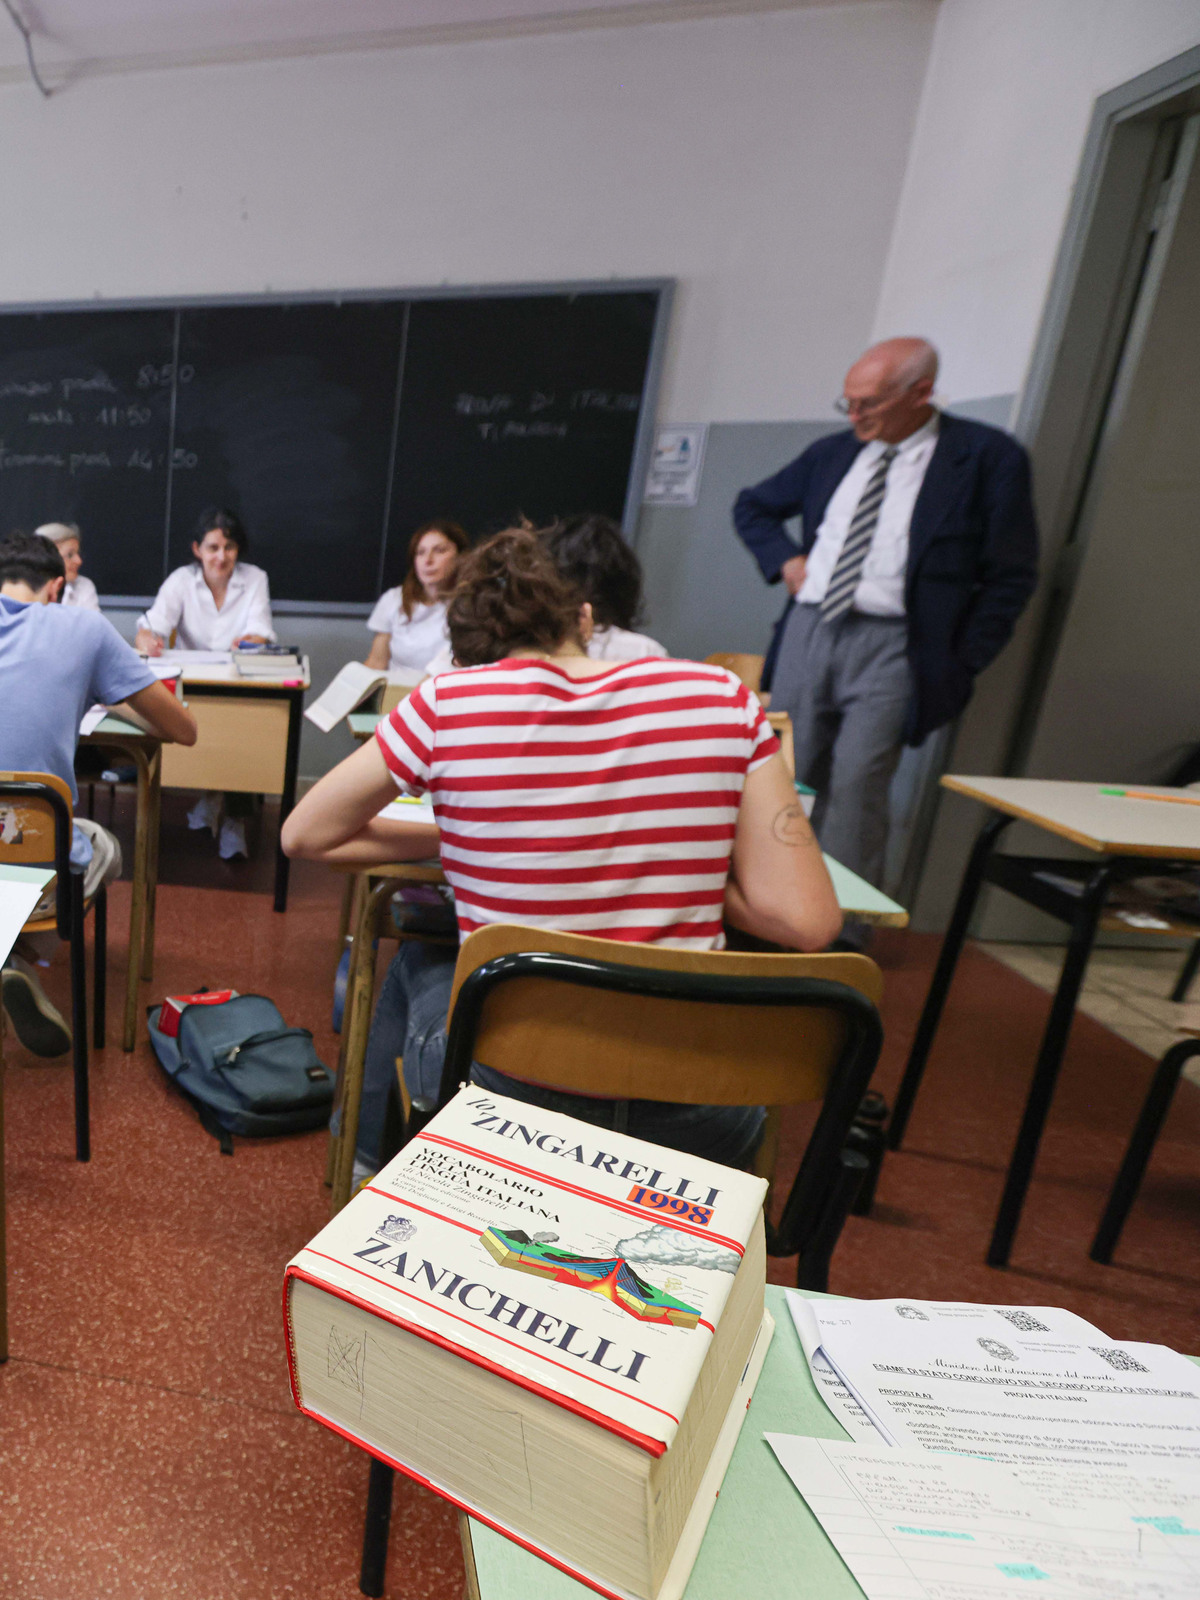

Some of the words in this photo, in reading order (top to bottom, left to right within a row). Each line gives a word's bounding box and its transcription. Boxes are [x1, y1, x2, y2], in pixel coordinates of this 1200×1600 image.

[466, 1098, 497, 1111] lo
[415, 1153, 470, 1178] DELLA
[423, 1147, 544, 1198] VOCABOLARIO
[470, 1111, 724, 1208] ZINGARELLI
[398, 1172, 443, 1190] Dodicesima
[442, 1187, 471, 1204] edizione
[400, 1180, 416, 1189] cura
[409, 1159, 471, 1188] LINGUA
[477, 1185, 561, 1223] ITALIANA
[416, 1170, 452, 1188] Nicola
[452, 1183, 509, 1211] Zingarelli
[446, 1203, 466, 1215] Luigi
[467, 1210, 498, 1227] Rosiello
[630, 1187, 713, 1226] 1998
[353, 1237, 651, 1384] ZANICHELLI
[873, 1363, 906, 1373] ESAME
[907, 1367, 919, 1375] DI
[919, 1369, 952, 1380] STATO
[953, 1373, 1017, 1386] CONCLUSIVO
[1018, 1379, 1038, 1388] DEL
[1039, 1380, 1090, 1391] SECONDO
[1090, 1384, 1123, 1393] CICLO
[928, 1358, 980, 1372] Ministero
[1063, 1370, 1079, 1378] del
[878, 1388, 921, 1398] PROPOSTA
[887, 1400, 907, 1408] Luigi
[1003, 1391, 1036, 1400] PROVA
[1046, 1394, 1088, 1403] ITALIANO
